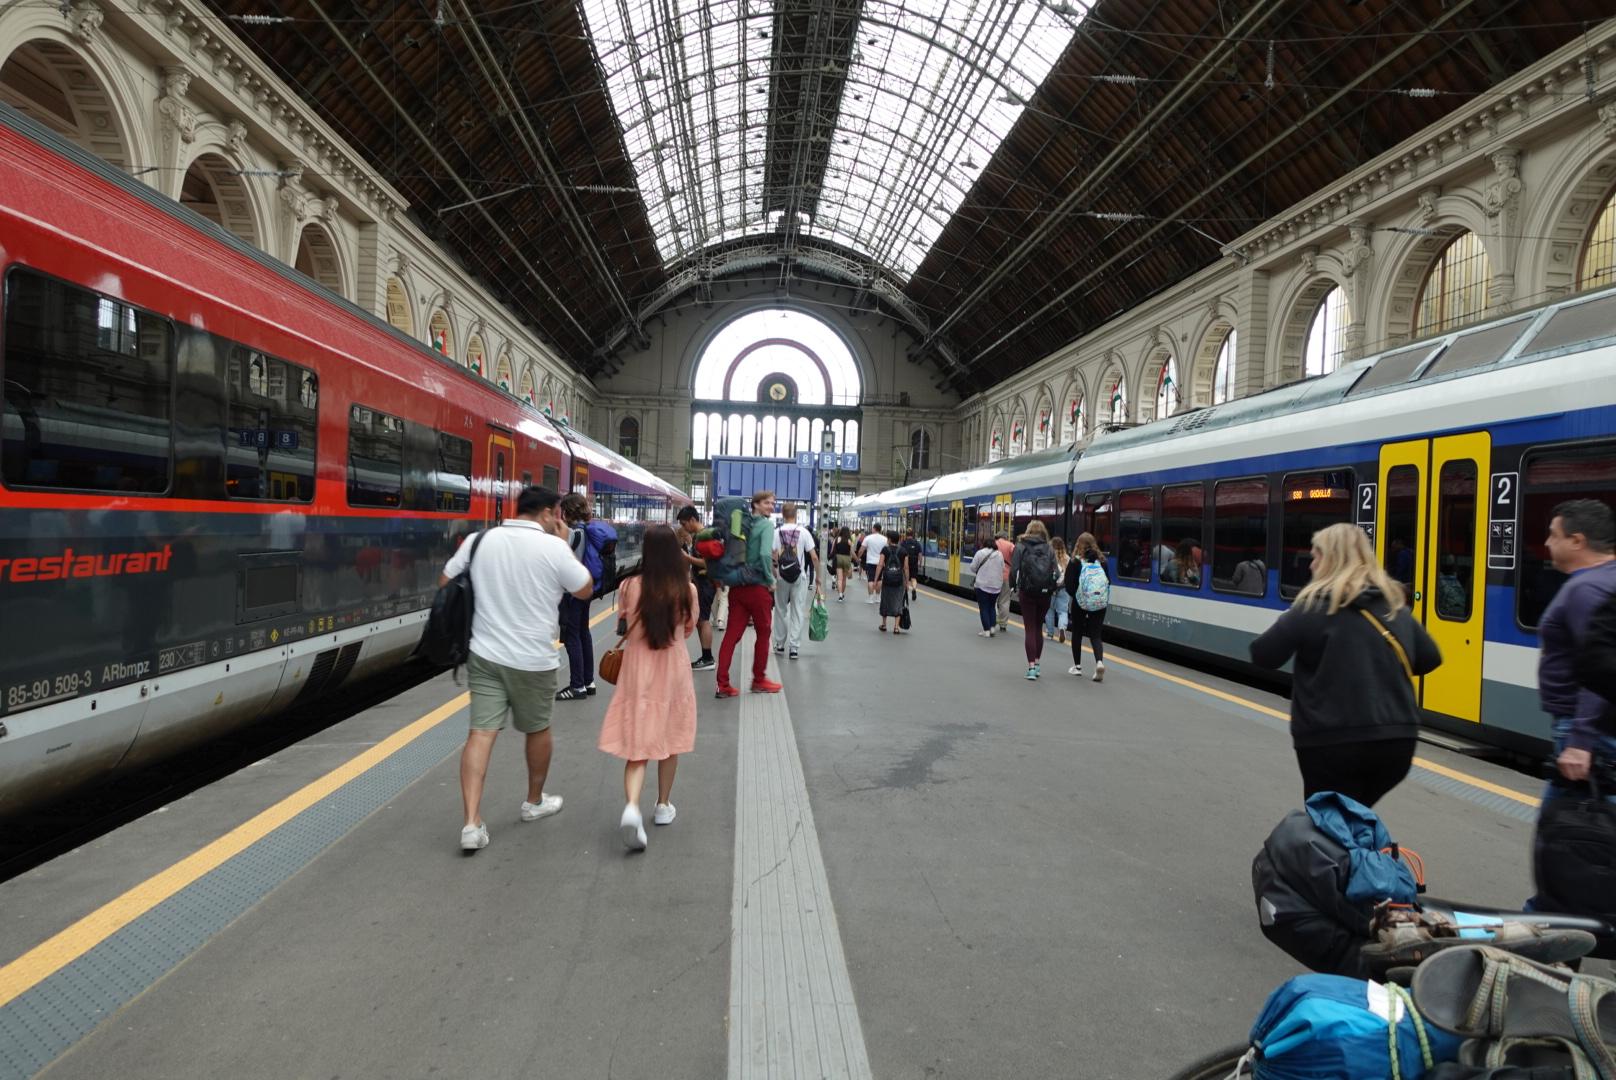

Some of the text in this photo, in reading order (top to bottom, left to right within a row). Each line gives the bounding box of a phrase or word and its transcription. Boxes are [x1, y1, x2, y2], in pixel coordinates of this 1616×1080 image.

[802, 454, 809, 463] 8
[824, 455, 832, 464] B
[846, 456, 852, 465] 7
[1361, 487, 1372, 510] 2
[1497, 477, 1511, 504] 2
[159, 651, 175, 670] 230
[8, 680, 50, 706] 85-90
[55, 670, 92, 694] 509-3
[102, 660, 150, 684] ARbmpz
